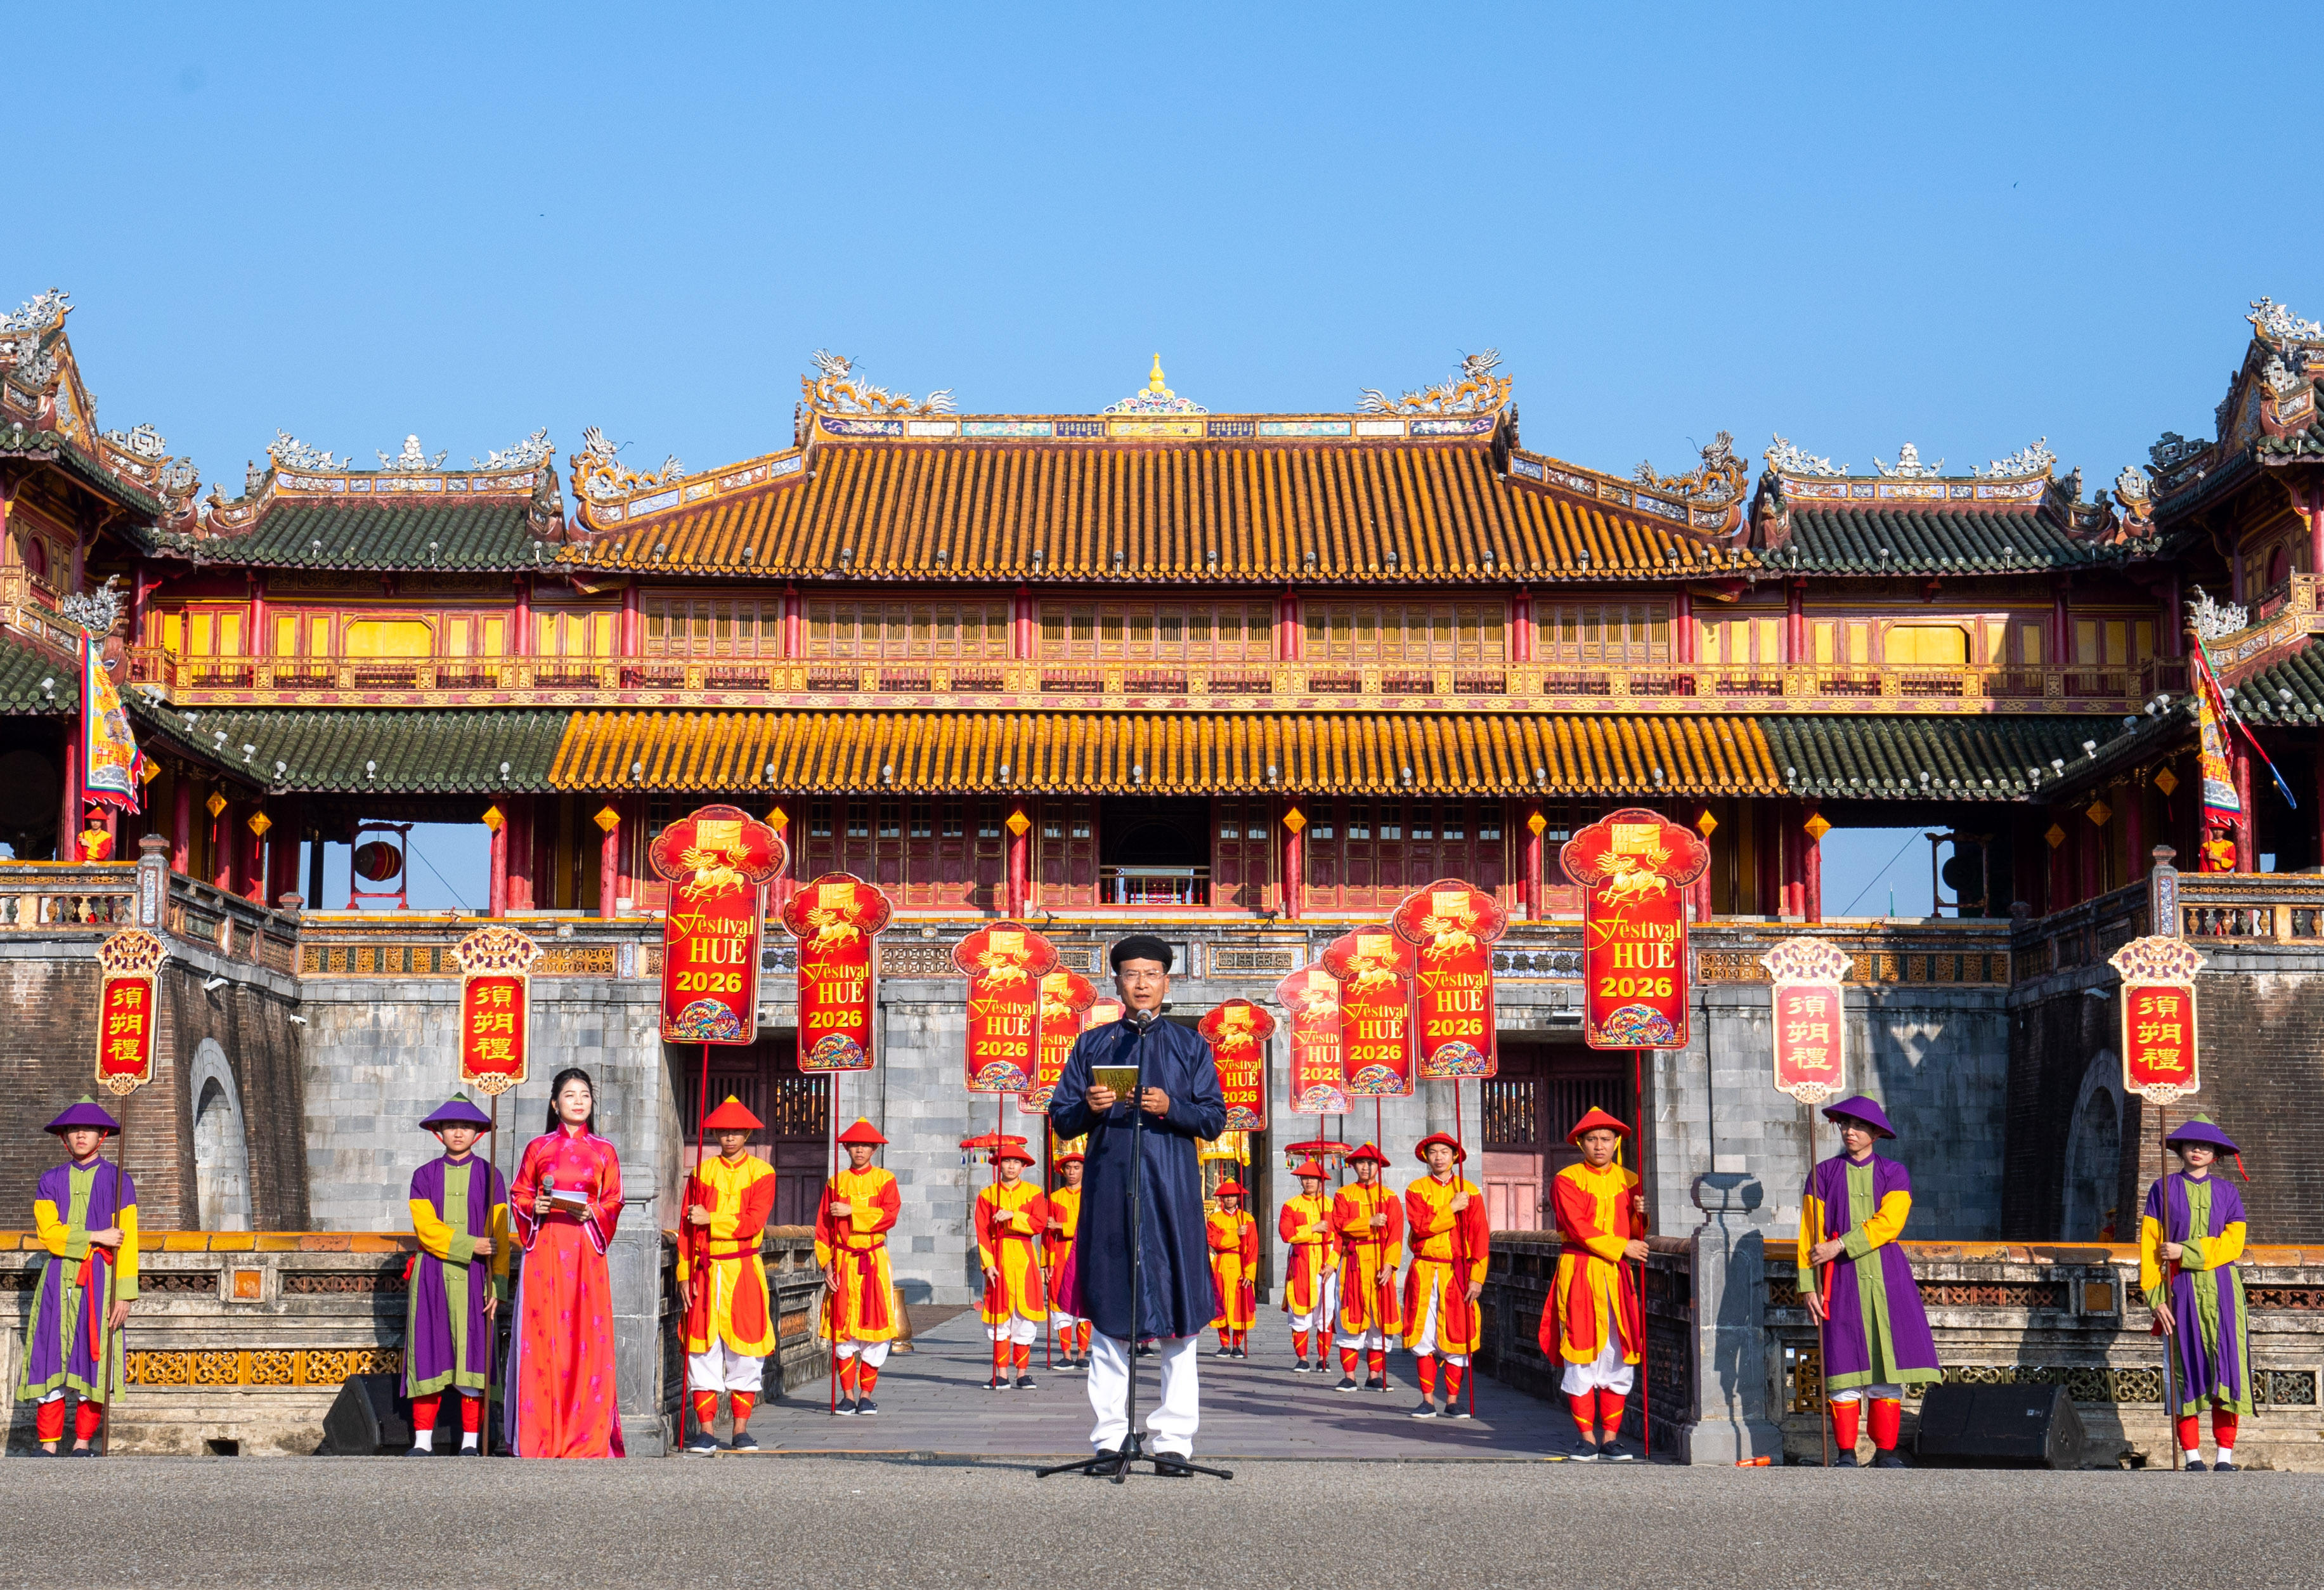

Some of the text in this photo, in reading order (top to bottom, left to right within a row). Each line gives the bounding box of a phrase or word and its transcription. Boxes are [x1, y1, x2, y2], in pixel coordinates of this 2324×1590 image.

[675, 971, 743, 993] 2026
[1599, 977, 1673, 997] 2026
[808, 1010, 862, 1029] 2026
[1427, 1018, 1483, 1037] 2026
[1293, 1021, 1339, 1051] Festiv
[975, 1041, 1029, 1057] 2026
[1349, 1045, 1402, 1060] 2026
[1039, 1069, 1061, 1082] 02
[1223, 1091, 1257, 1104] 2026
